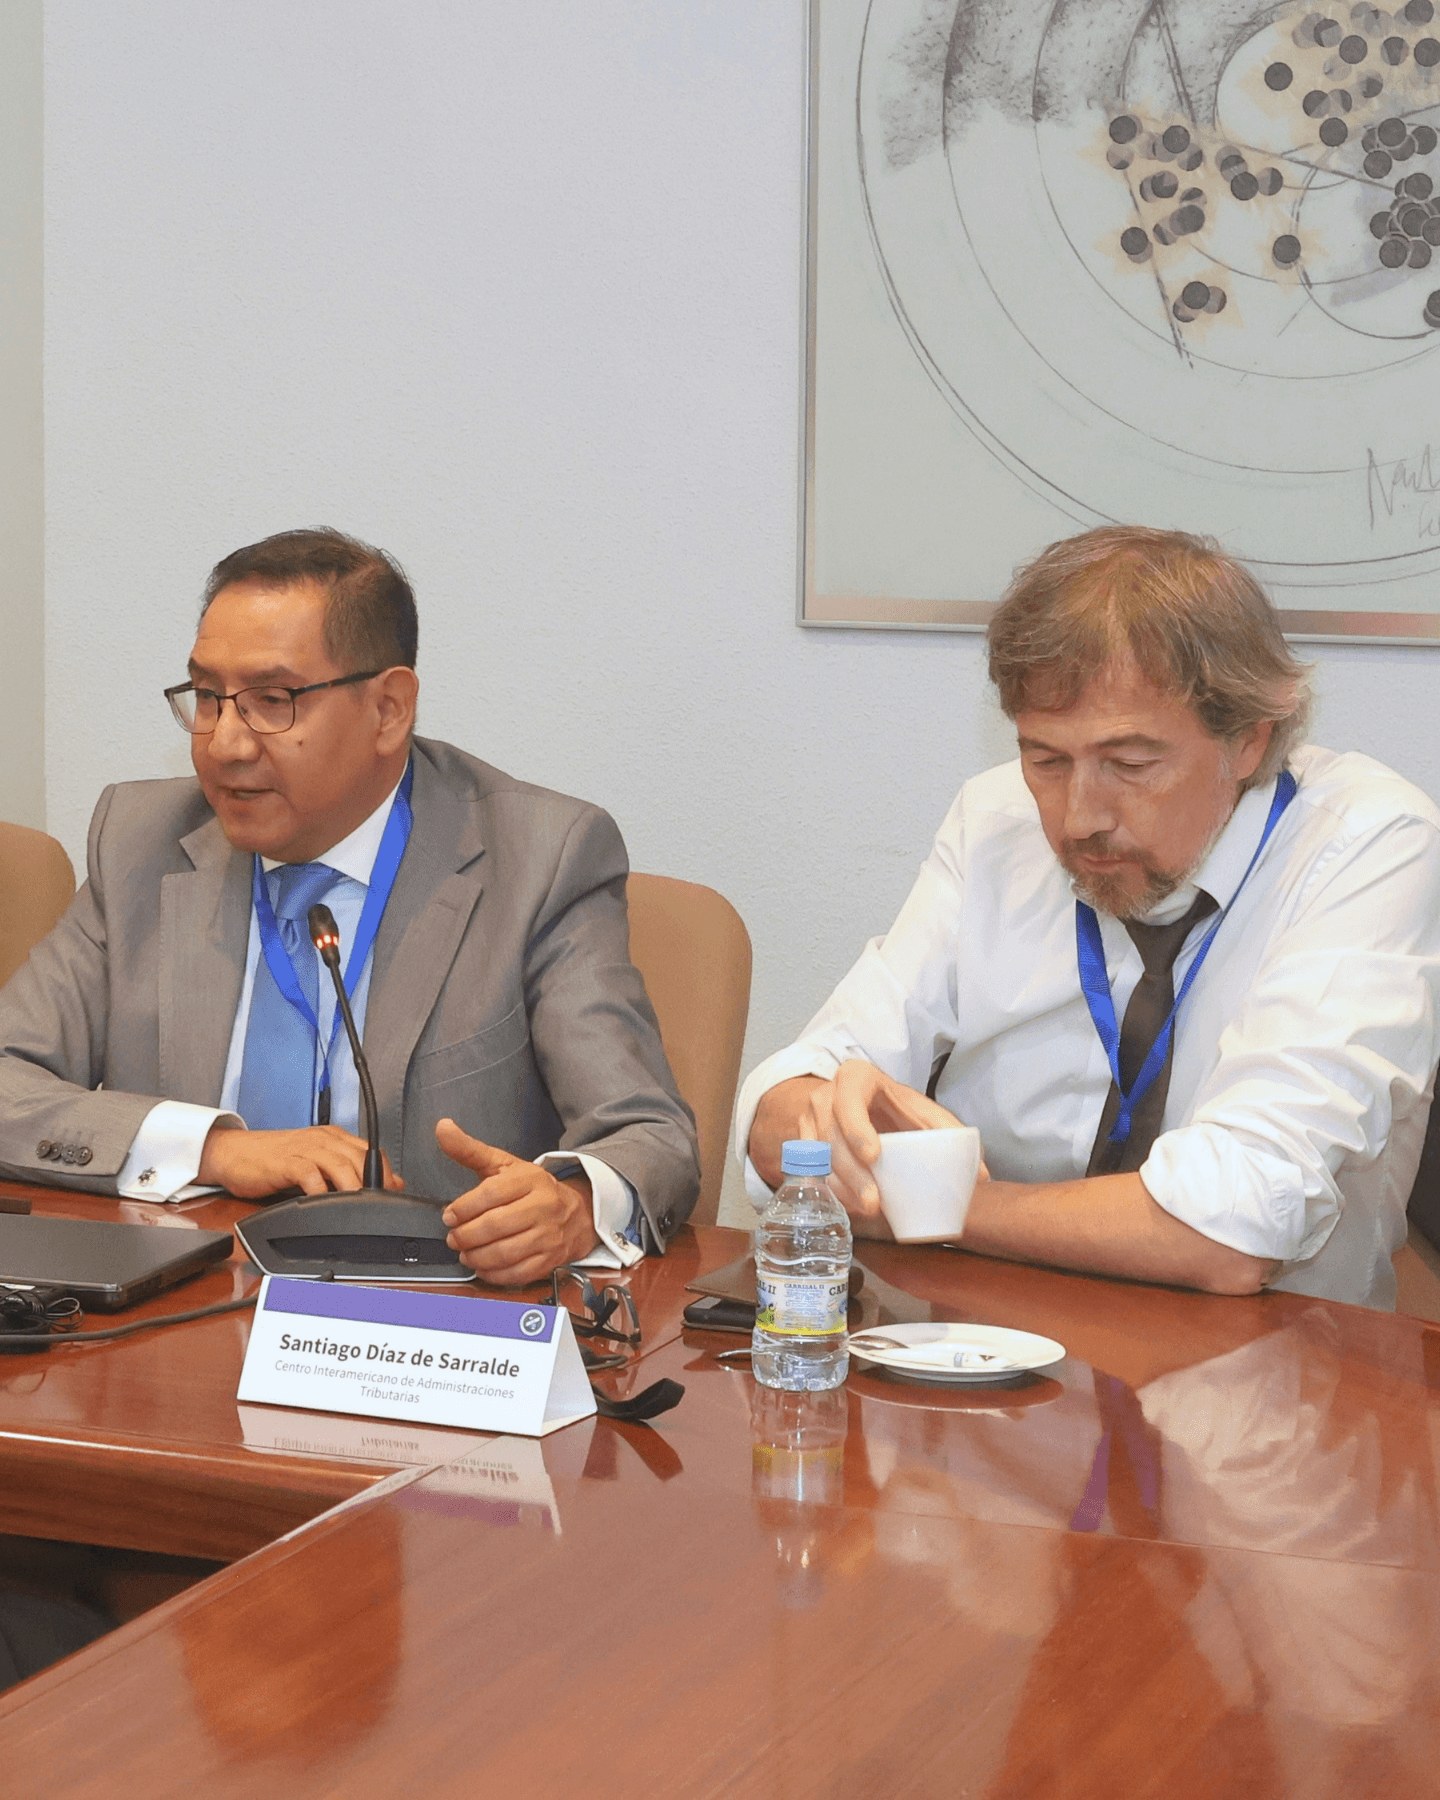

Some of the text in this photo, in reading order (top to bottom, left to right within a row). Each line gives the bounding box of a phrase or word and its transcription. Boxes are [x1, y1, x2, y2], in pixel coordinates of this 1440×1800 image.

[280, 1334, 520, 1377] Santiago Díaz de Sarralde
[275, 1360, 515, 1399] Centro Interamericano de Administraciones
[360, 1386, 420, 1403] Tributarias
